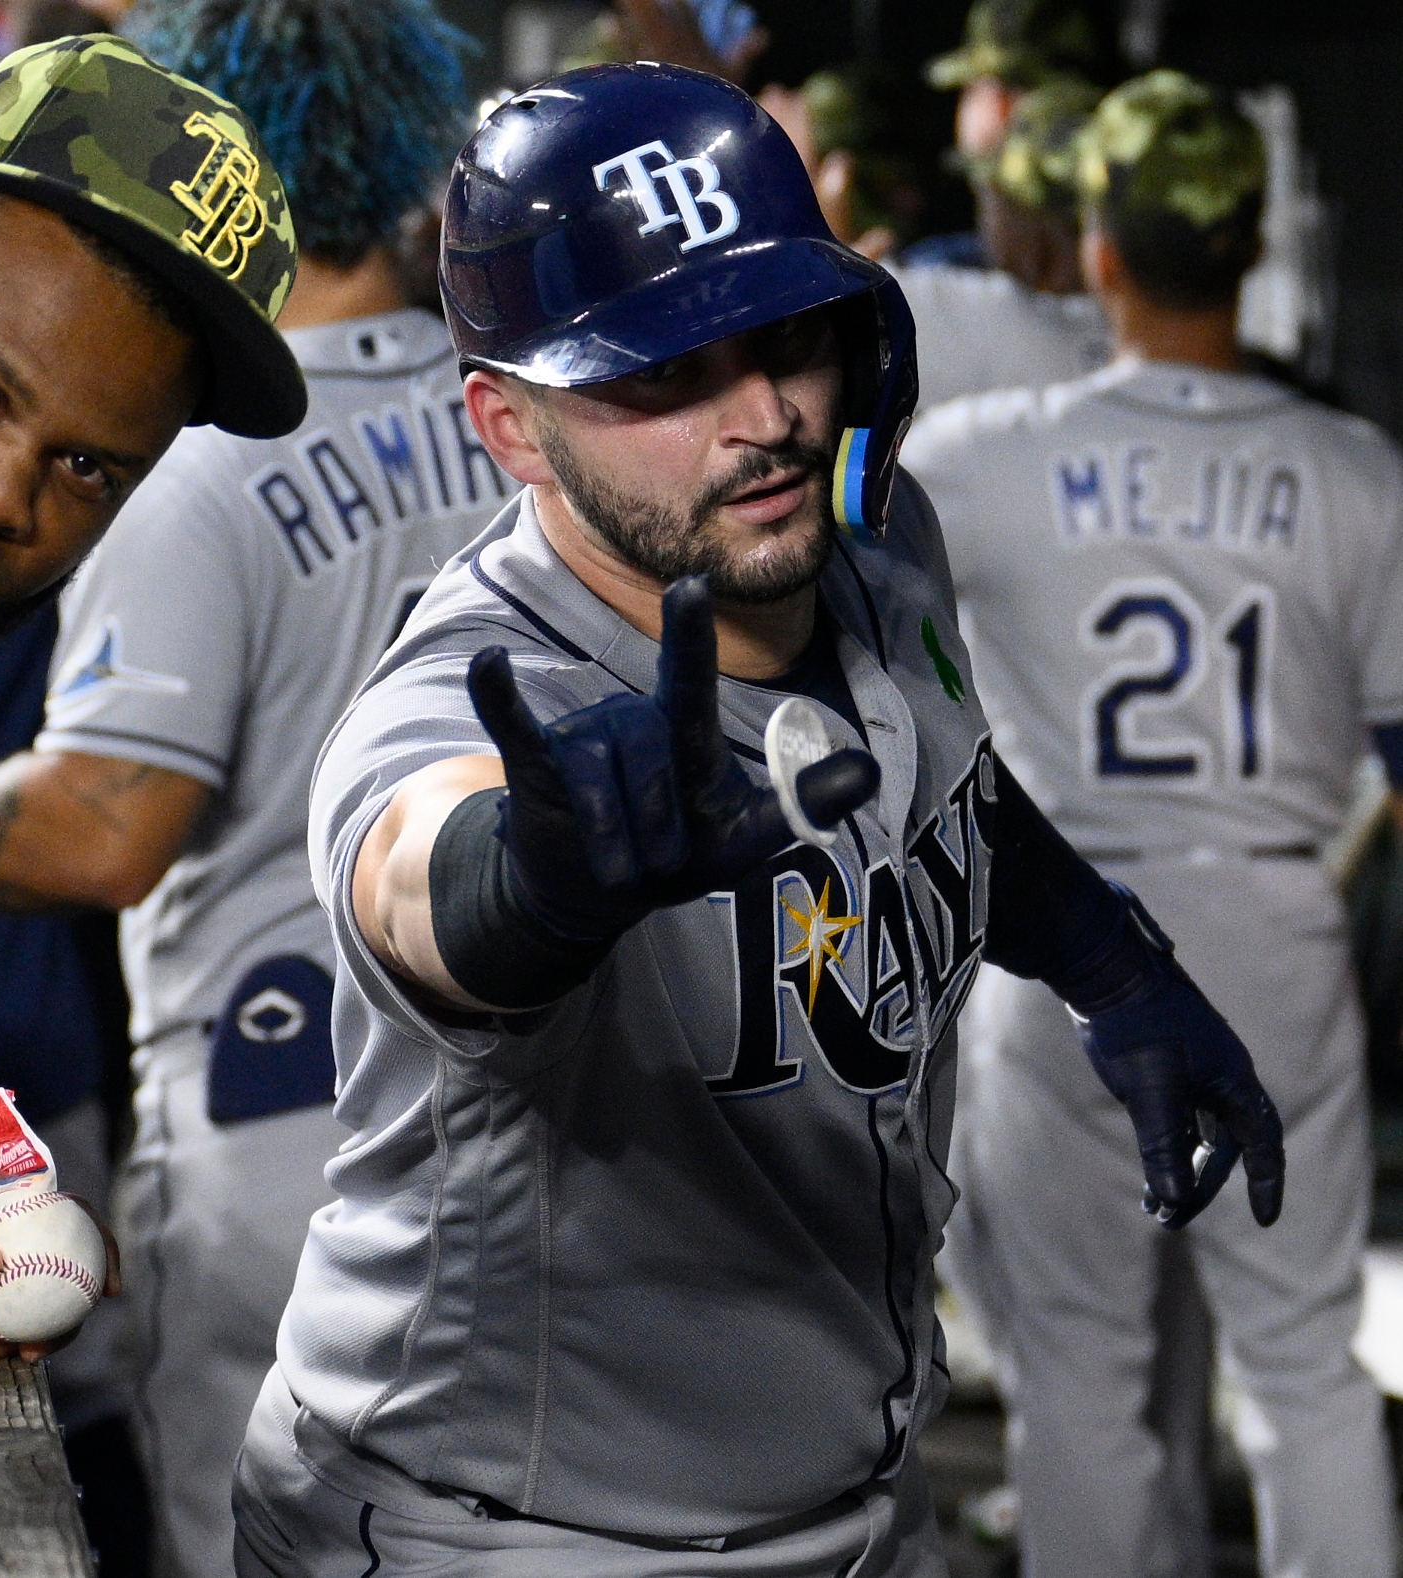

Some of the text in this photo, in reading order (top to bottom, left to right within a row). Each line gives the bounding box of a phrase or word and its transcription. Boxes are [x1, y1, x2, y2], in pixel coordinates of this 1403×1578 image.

[169, 110, 268, 281] TB
[592, 139, 741, 255] TB
[1057, 446, 1301, 546] MEJIA
[1091, 592, 1263, 780] 21
